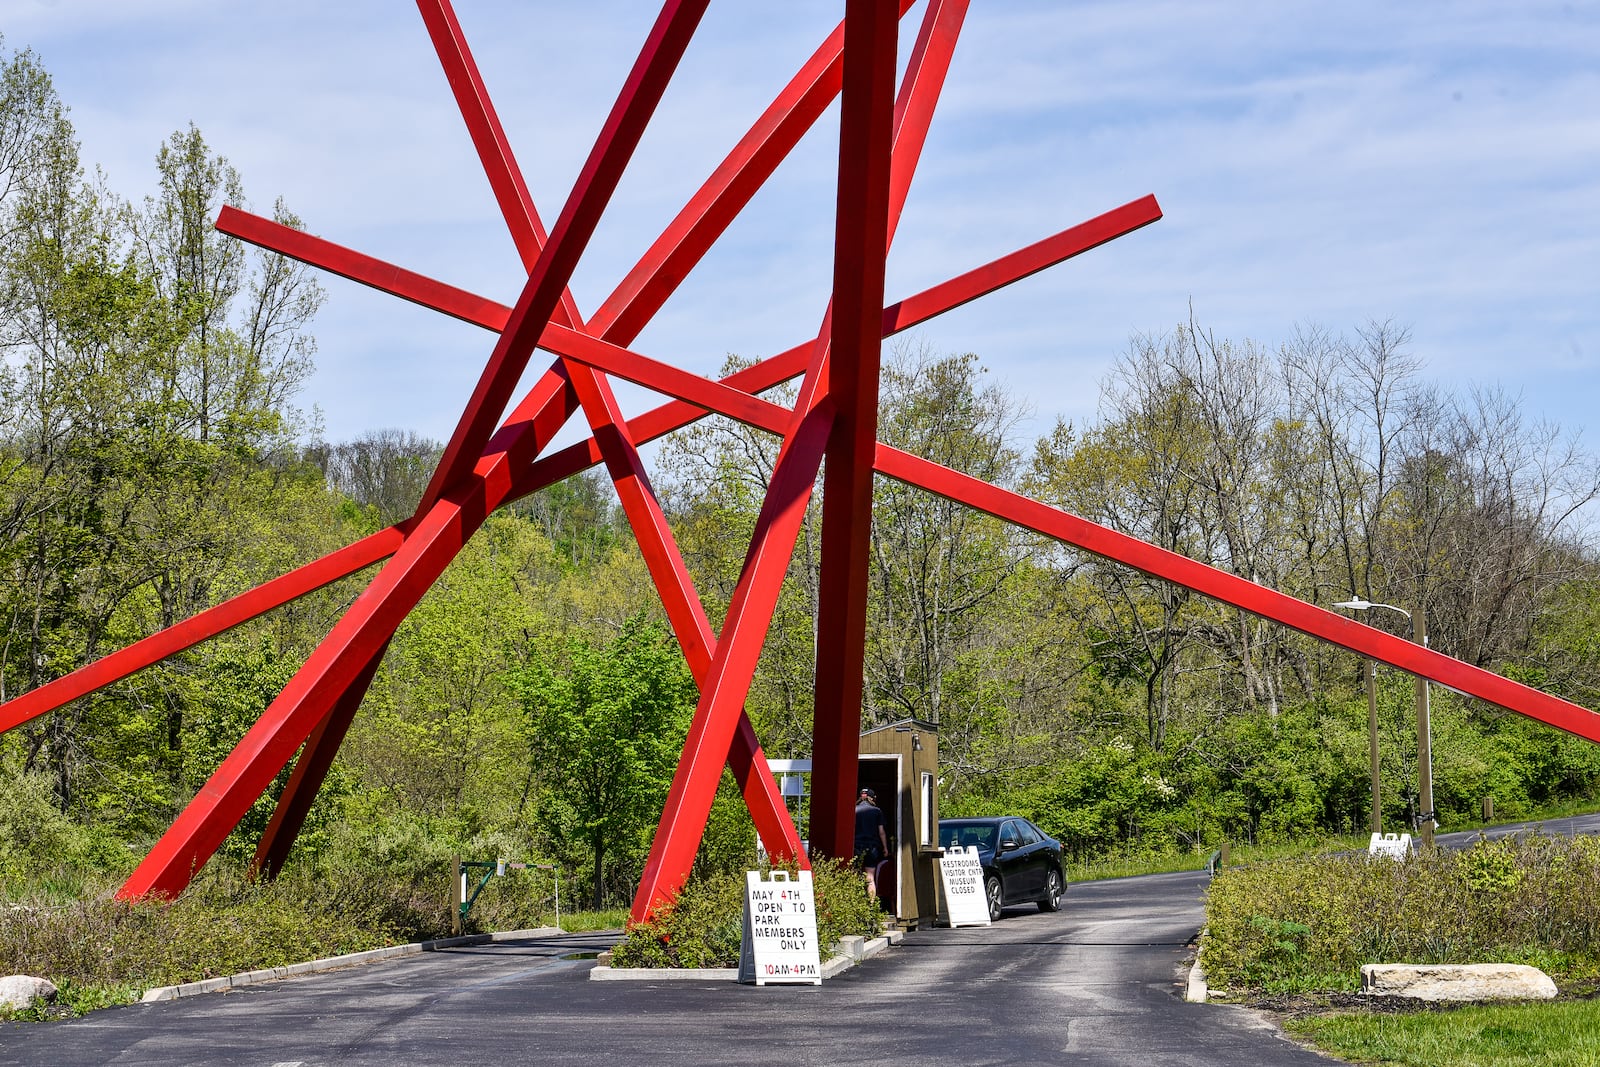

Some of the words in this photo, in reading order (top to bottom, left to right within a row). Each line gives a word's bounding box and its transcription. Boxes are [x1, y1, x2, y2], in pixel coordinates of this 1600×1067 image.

[943, 860, 979, 868] RESTROOMS
[944, 869, 966, 877] VISITOR
[949, 878, 976, 886] MUSEUM
[752, 890, 774, 901] MAY
[781, 890, 801, 901] 4TH
[757, 902, 783, 913] OPEN
[792, 902, 806, 913] TO
[755, 915, 780, 926] PARK
[755, 927, 805, 938] MEMBERS
[780, 940, 807, 950] ONLY
[764, 964, 816, 975] 10AM-4PM
